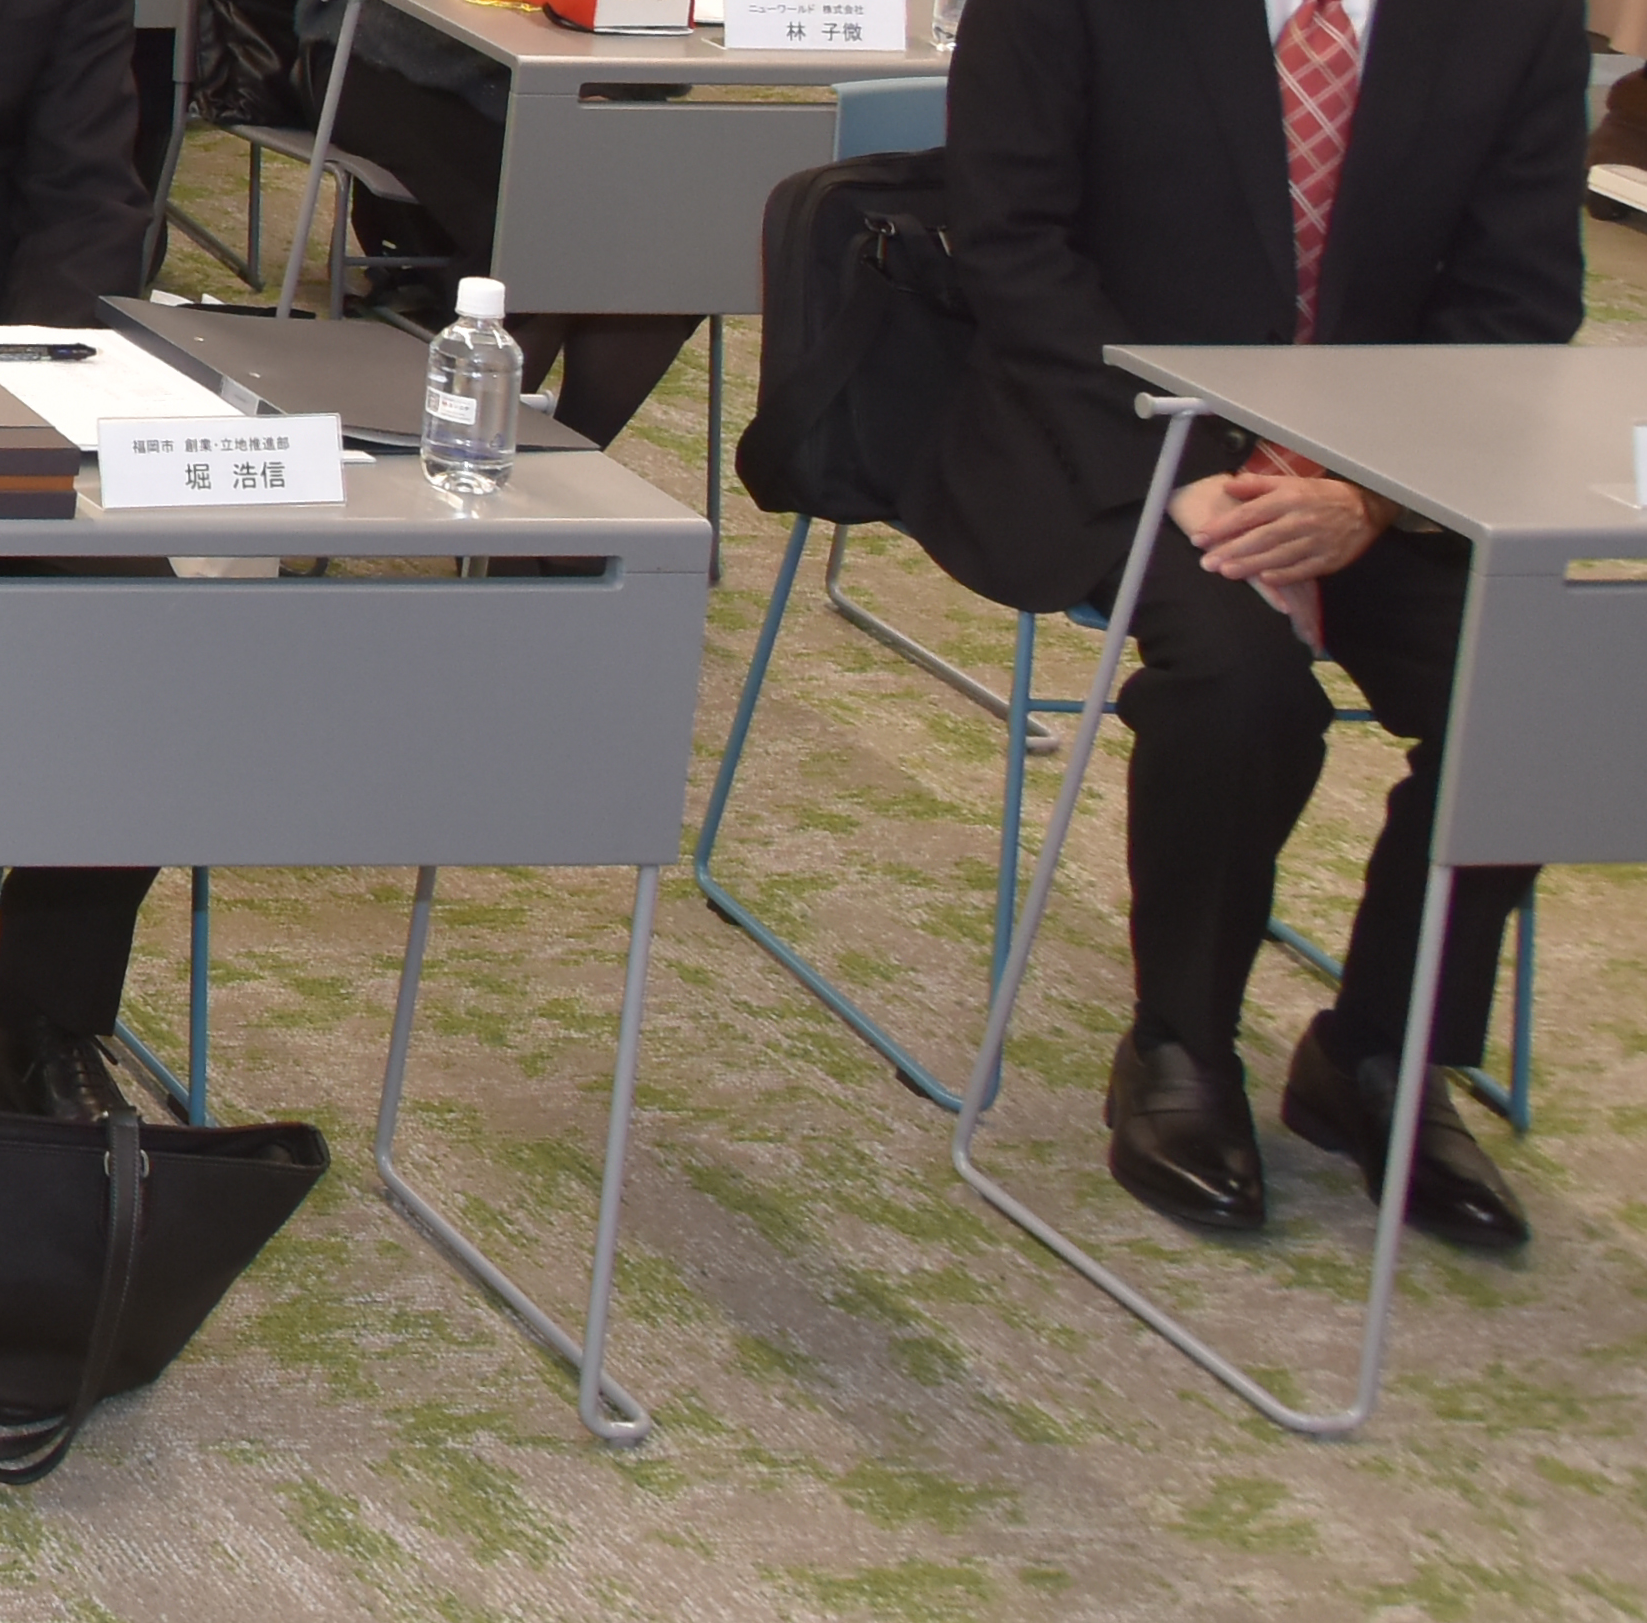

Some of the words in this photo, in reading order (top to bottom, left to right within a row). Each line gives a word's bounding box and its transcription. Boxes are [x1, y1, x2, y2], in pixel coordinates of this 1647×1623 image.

[749, 4, 815, 14] ニューワールド
[822, 4, 864, 15] 株式会社
[786, 21, 807, 42] 林
[132, 439, 174, 454] 福岡市
[185, 463, 212, 490] 堀
[233, 461, 286, 489] 浩信
